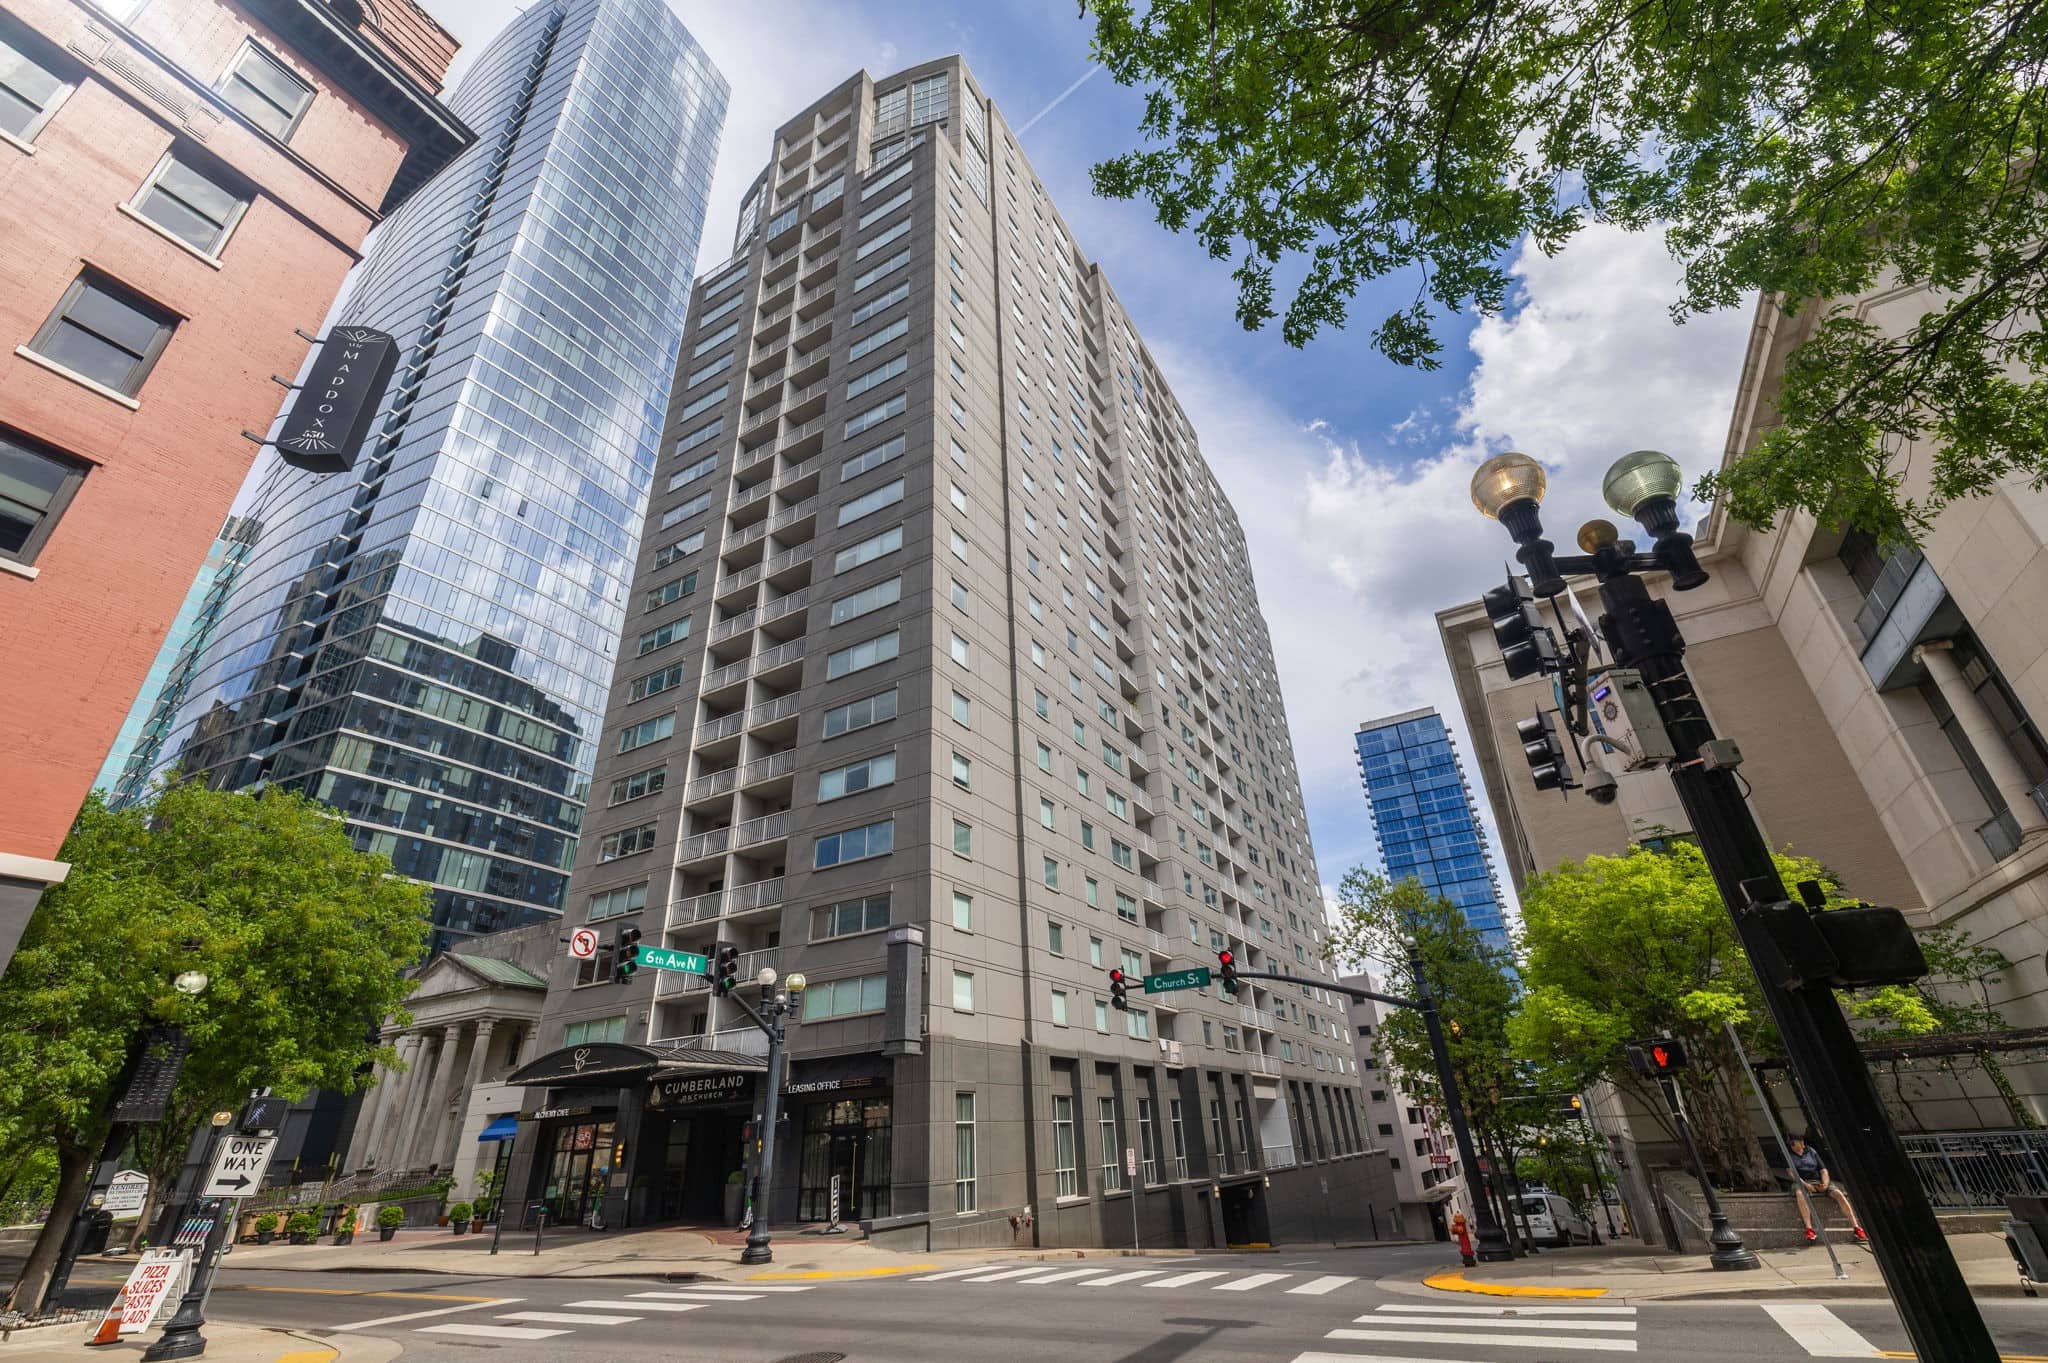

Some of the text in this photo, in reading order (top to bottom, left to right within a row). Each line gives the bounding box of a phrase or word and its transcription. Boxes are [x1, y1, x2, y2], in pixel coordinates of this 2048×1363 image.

[312, 350, 360, 428] MADDOX
[645, 950, 697, 971] 6th Ave N
[1153, 972, 1200, 989] Church St
[665, 1075, 744, 1095] CUMBERLAND
[788, 1080, 840, 1094] LEASING OFFICE
[231, 1141, 267, 1155] ONE
[223, 1156, 262, 1171] WAY
[141, 1265, 170, 1279] PIZZA
[129, 1280, 166, 1295] SLICES
[120, 1309, 150, 1325] LADS
